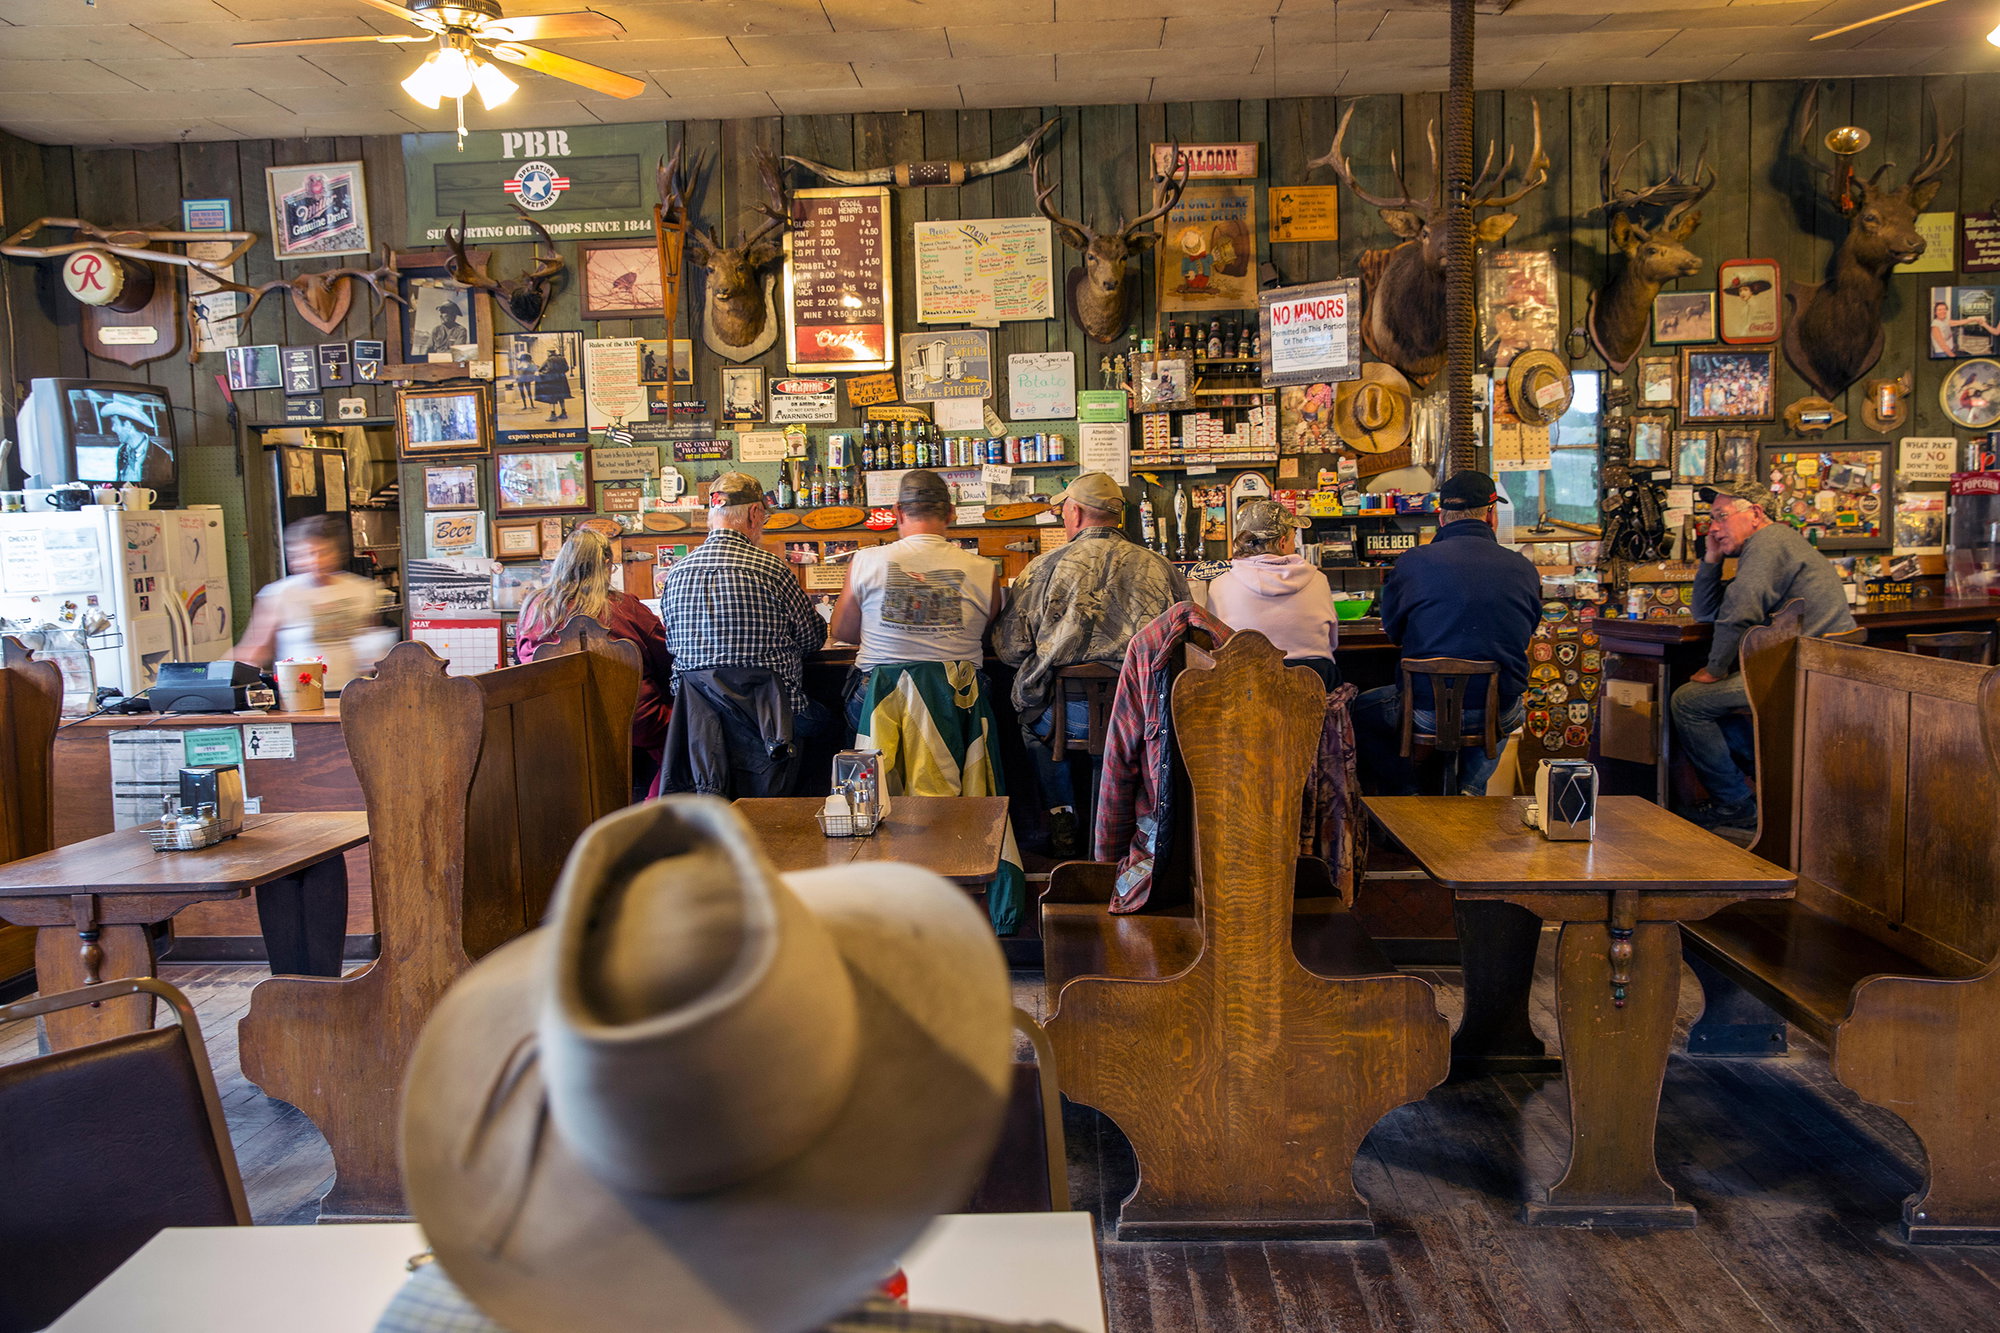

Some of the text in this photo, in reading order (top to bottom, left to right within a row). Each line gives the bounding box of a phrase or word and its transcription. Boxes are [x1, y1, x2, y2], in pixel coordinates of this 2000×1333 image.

[501, 130, 571, 158] PBR
[1177, 150, 1237, 172] SALOON
[518, 164, 556, 179] OPERATION
[518, 192, 556, 208] HOMEFRONT
[296, 194, 337, 221] Miller
[292, 208, 348, 236] Genuine Draft
[427, 220, 651, 240] SUPRTING OUR ROOPS SINCE 1844
[965, 224, 989, 244] Menu
[795, 249, 803, 257] LG
[821, 248, 840, 256] 10.00
[70, 254, 106, 292] R
[796, 288, 813, 296] RACK
[818, 299, 838, 307] 22.00
[804, 311, 822, 319] WINE
[853, 309, 876, 317] GLASS
[1273, 298, 1344, 326] NO MINORS
[1272, 328, 1299, 337] Permitted
[1309, 324, 1321, 332] This
[1324, 322, 1346, 330] Portion
[815, 329, 865, 347] Coors
[950, 336, 978, 345] What's
[785, 382, 824, 392] WARNING
[1017, 374, 1066, 388] Potato
[908, 390, 924, 399] with
[926, 388, 941, 398] this
[1926, 452, 1945, 461] NO
[1963, 480, 1999, 491] POPCORN
[437, 521, 472, 539] Beer
[1367, 535, 1415, 549] FREE BEER
[1664, 571, 1695, 580] Produ
[1884, 583, 1912, 593] STATE
